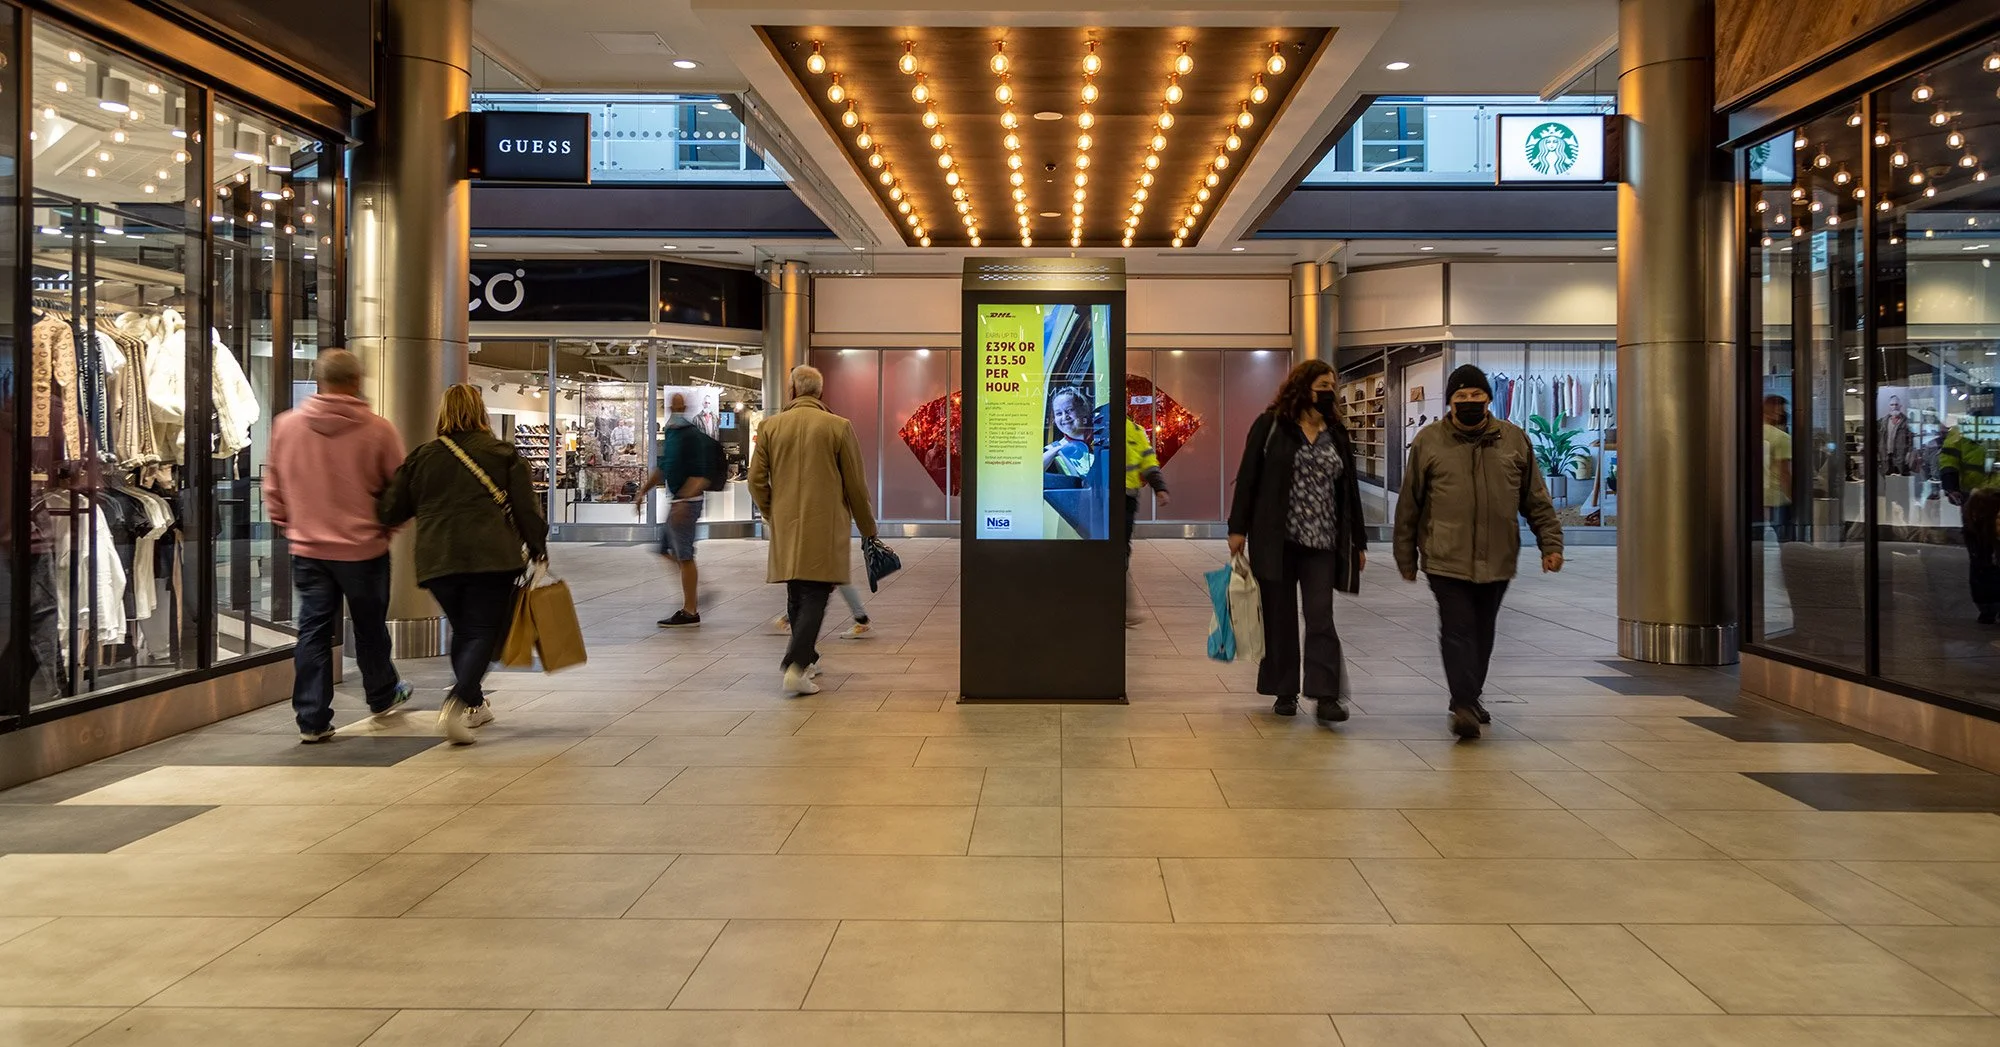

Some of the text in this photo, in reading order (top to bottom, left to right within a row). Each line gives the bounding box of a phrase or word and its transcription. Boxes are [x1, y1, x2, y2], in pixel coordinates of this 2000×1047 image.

[499, 139, 571, 154] GUESS
[985, 341, 1036, 352] £39K OR
[985, 355, 1027, 366] £15.50
[985, 368, 1009, 379] PER
[985, 382, 1020, 392] HOUR
[987, 517, 1010, 527] Nisa
